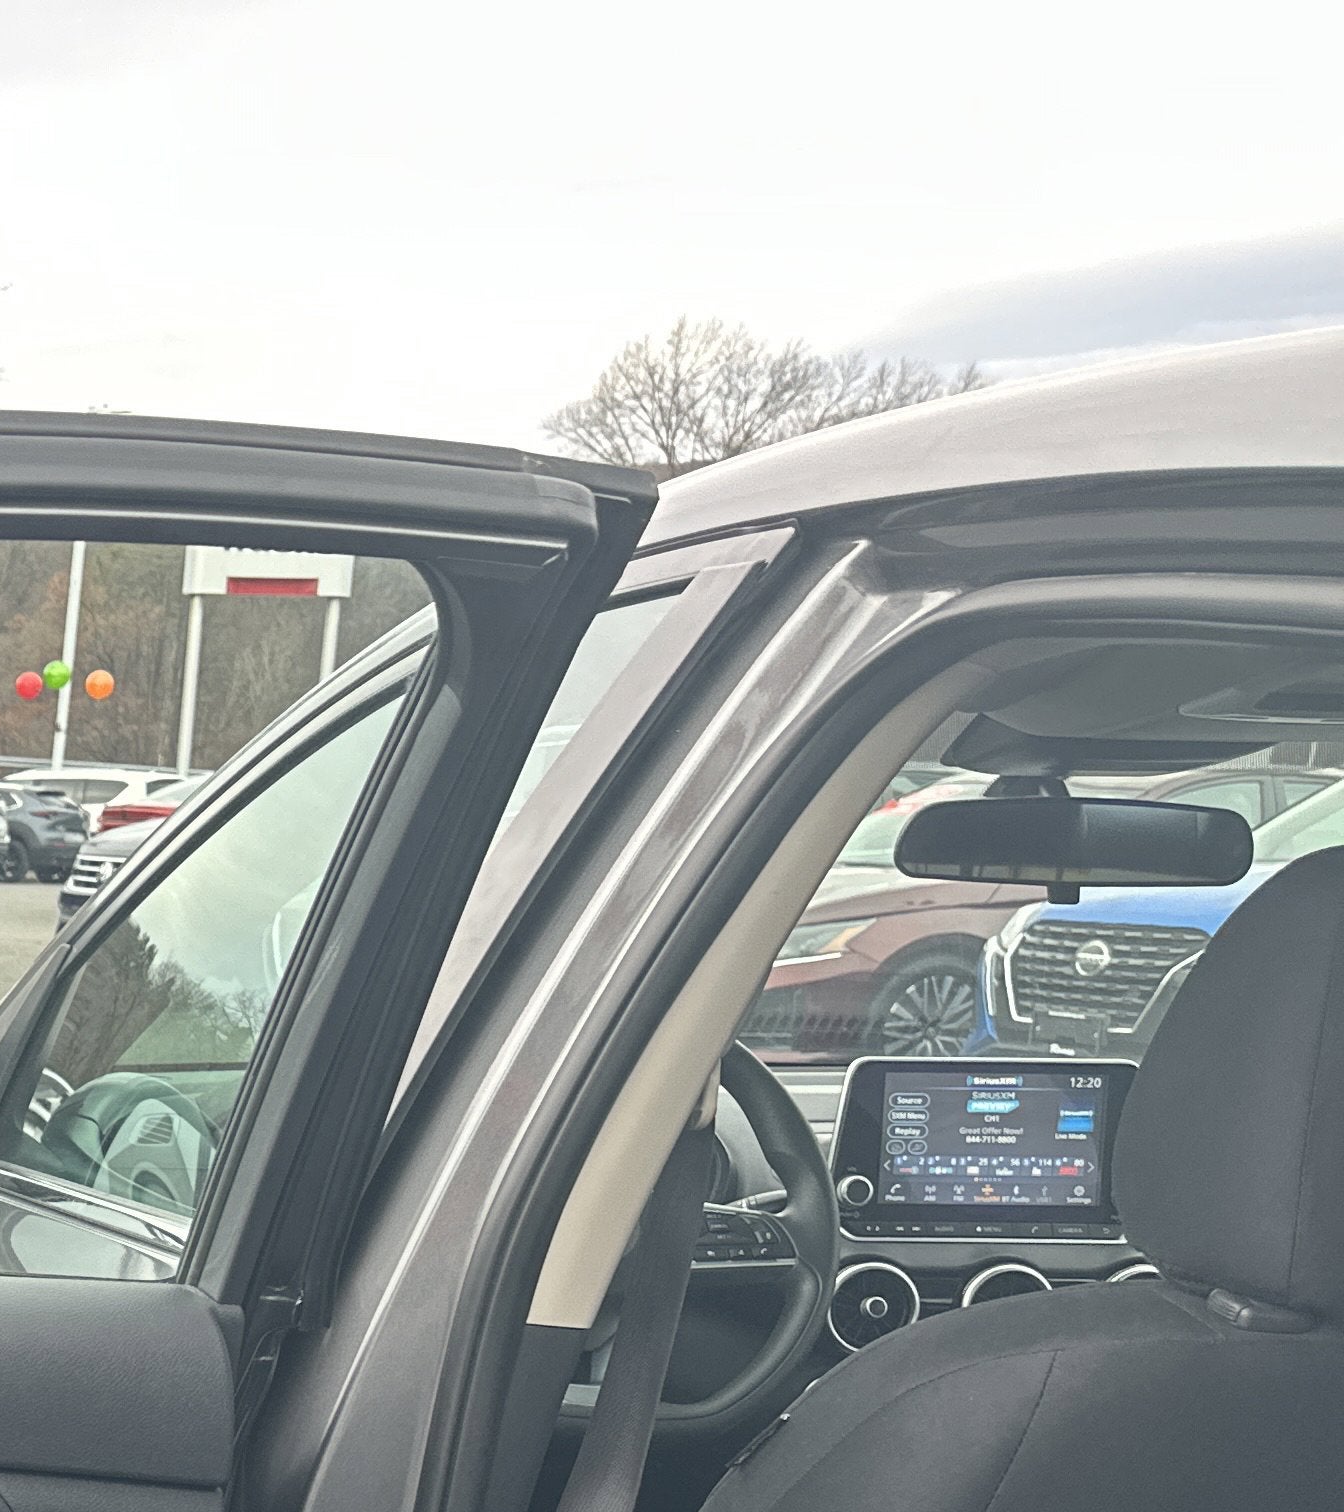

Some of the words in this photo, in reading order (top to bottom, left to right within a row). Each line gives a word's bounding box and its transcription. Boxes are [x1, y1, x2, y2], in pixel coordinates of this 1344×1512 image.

[1070, 1077, 1102, 1089] 12:20
[896, 1096, 923, 1105] Source
[907, 1112, 926, 1120] Menu
[894, 1127, 921, 1136] Replay
[959, 1127, 980, 1135] Great
[981, 1127, 1002, 1135] Offer
